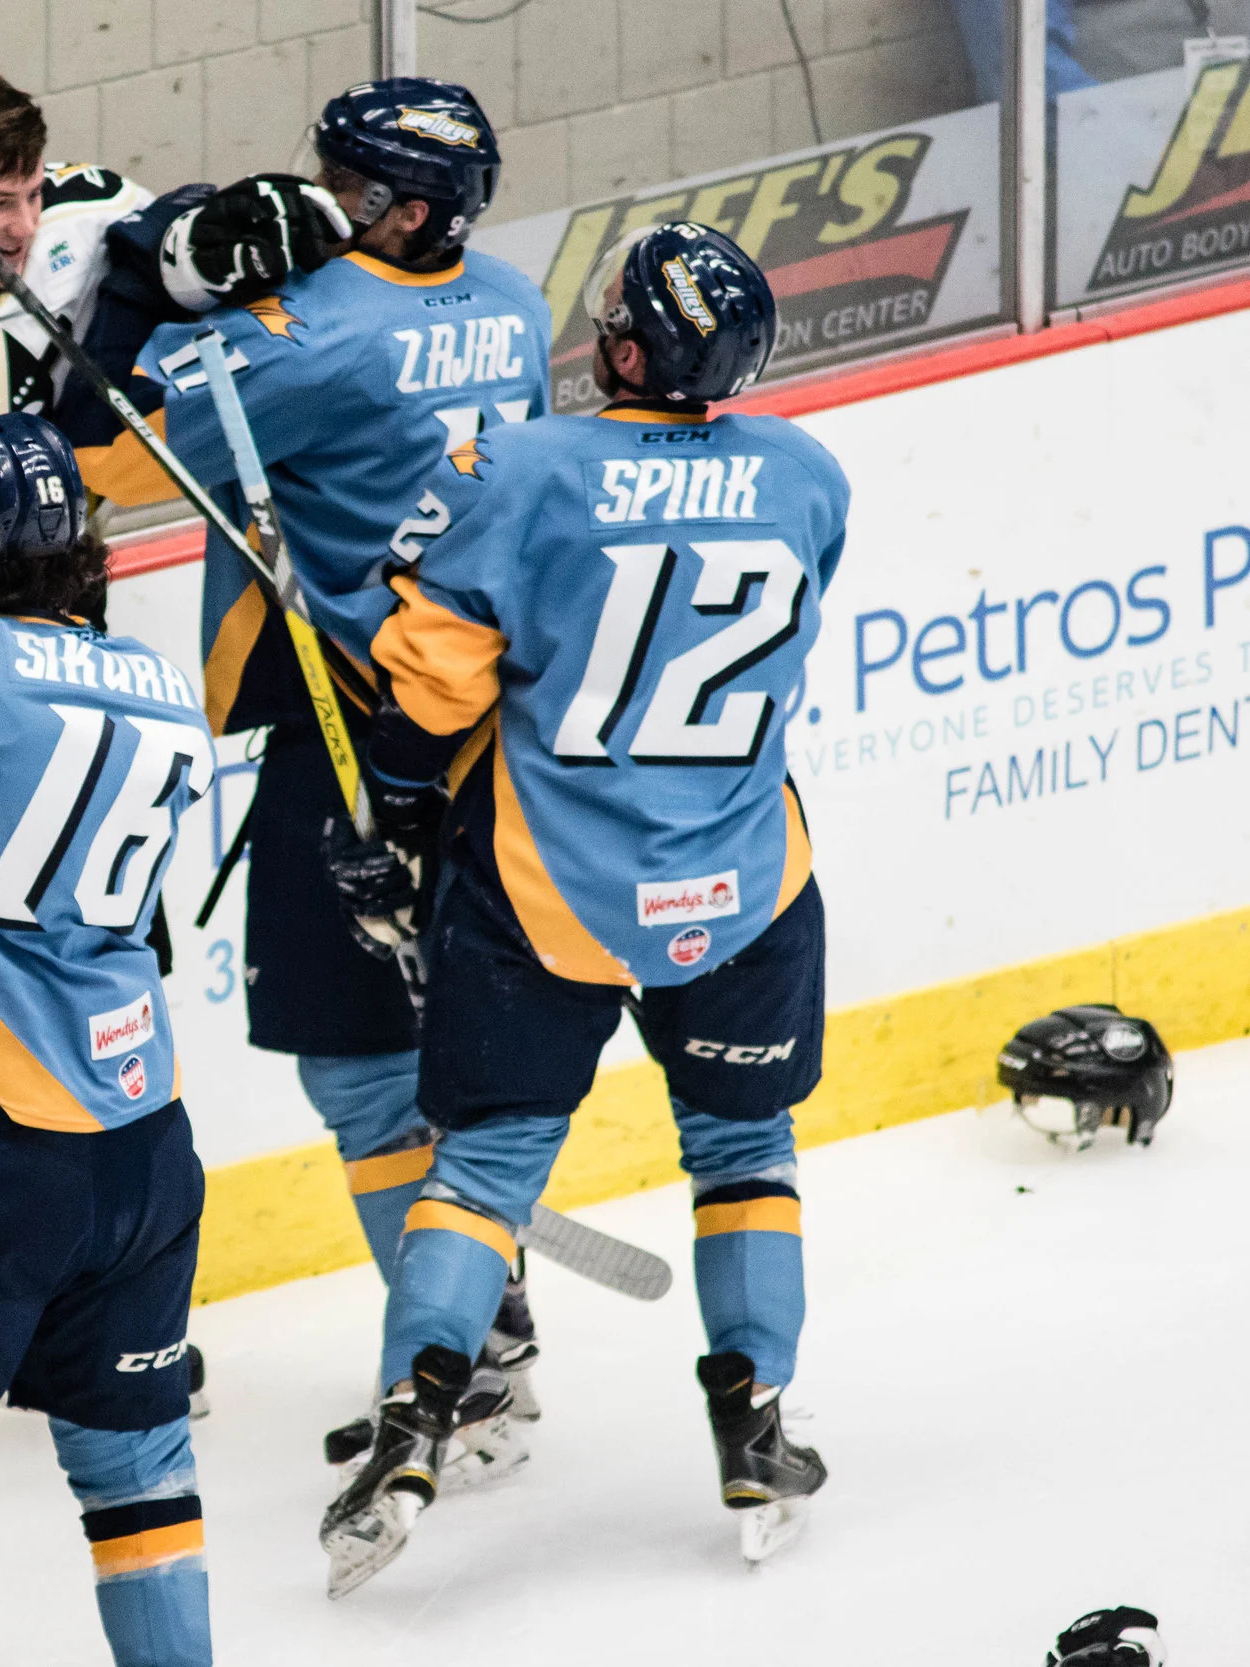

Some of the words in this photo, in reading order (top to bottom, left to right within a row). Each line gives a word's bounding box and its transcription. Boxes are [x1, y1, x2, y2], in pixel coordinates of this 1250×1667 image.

[1097, 240, 1172, 280] AUTO
[422, 292, 472, 308] CCM
[822, 289, 931, 342] CENTER
[393, 314, 525, 393] ZAJAC
[640, 429, 712, 444] CCM
[36, 475, 65, 505] 16
[595, 456, 764, 523] SPINK
[12, 630, 196, 709] SIKURA
[553, 539, 808, 767] 12
[854, 564, 1171, 713] Petros
[1013, 650, 1213, 729] DESERVES
[310, 688, 348, 767] TACKS
[944, 728, 1119, 820] FAMILY
[1136, 695, 1250, 772] DEN
[684, 1036, 797, 1065] CCM
